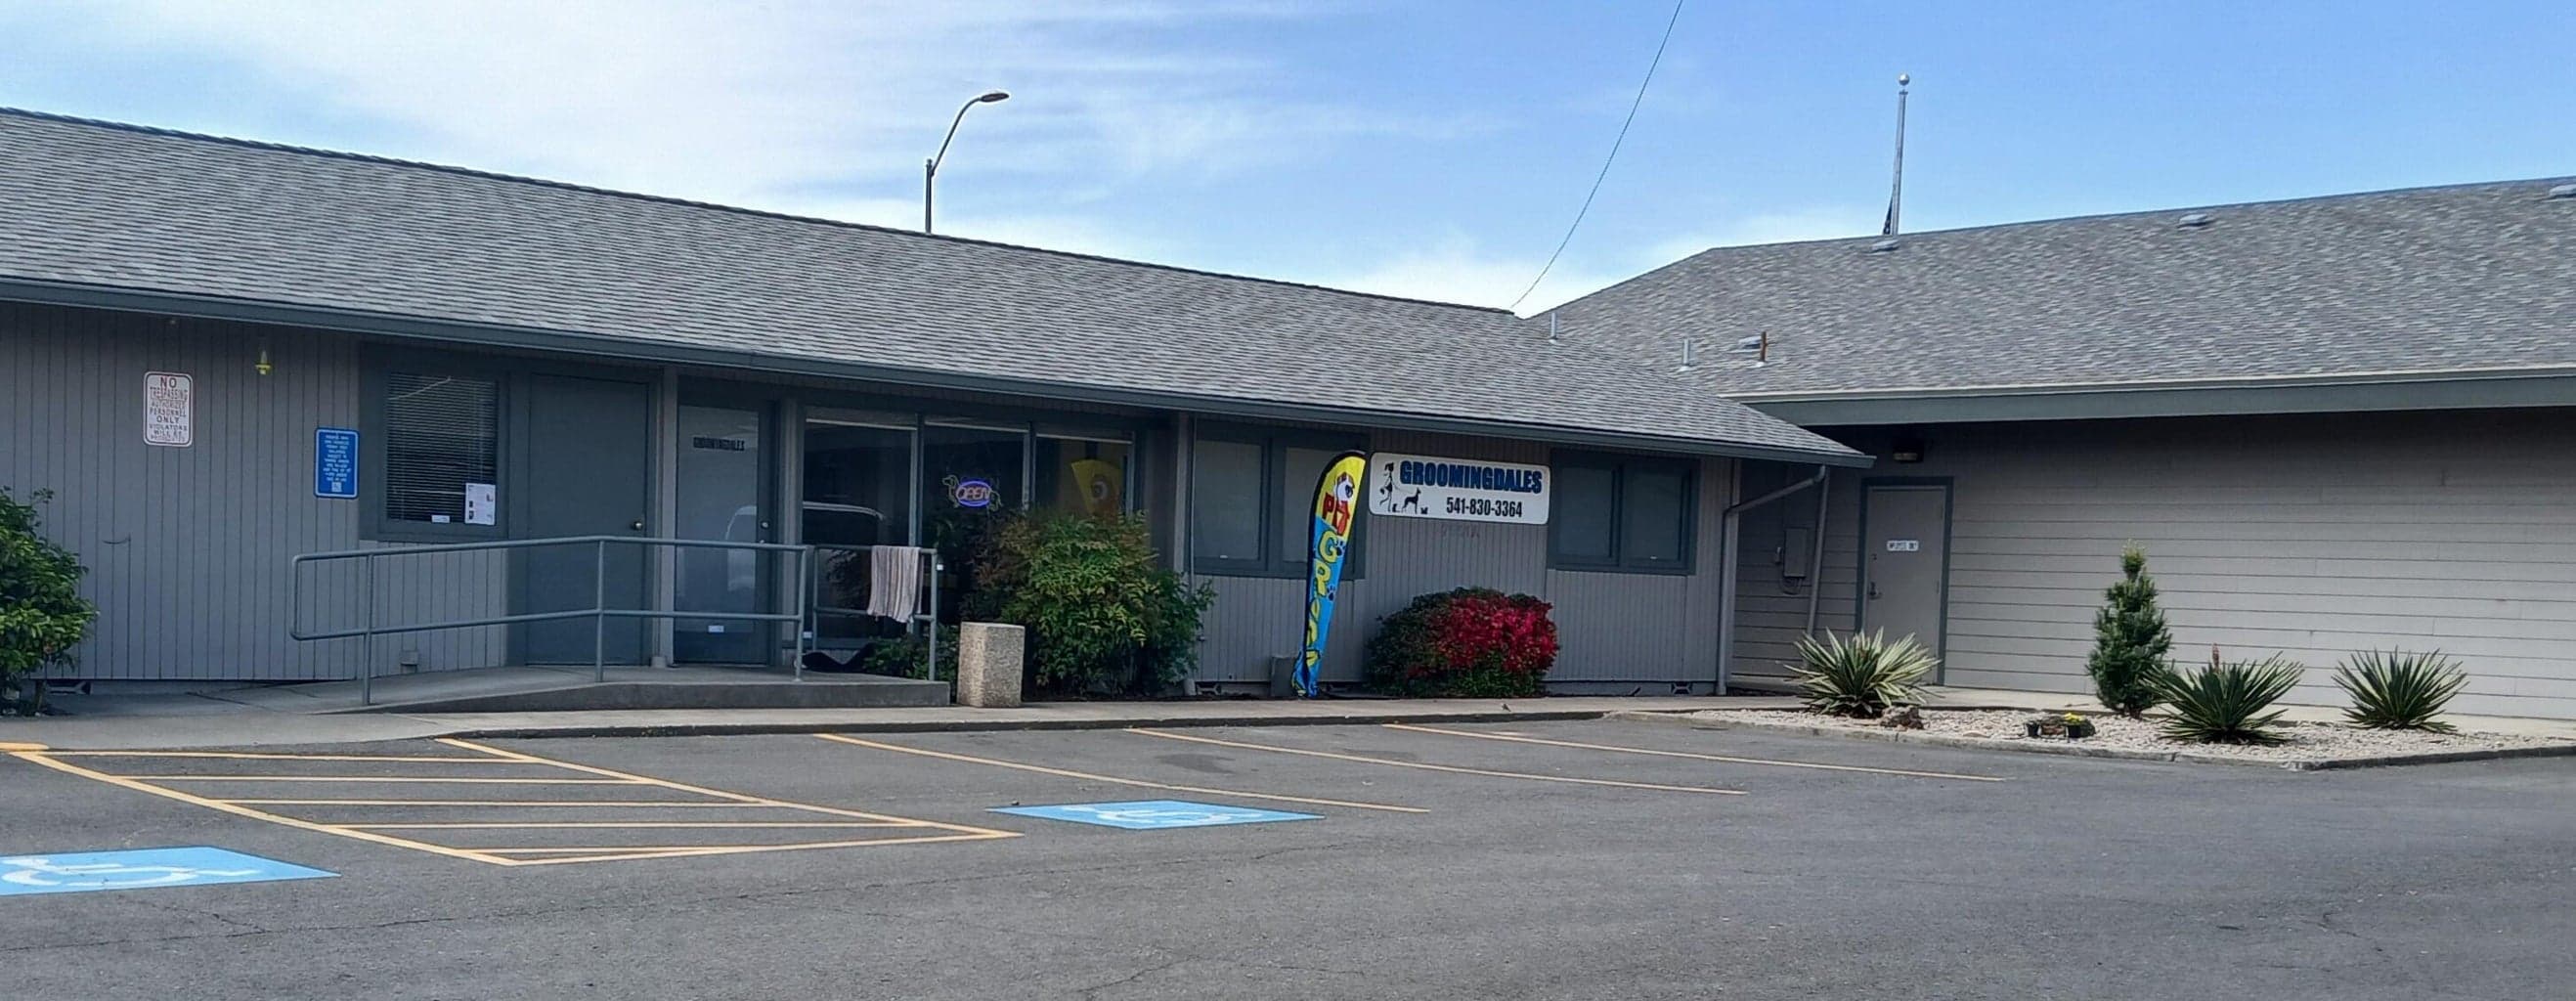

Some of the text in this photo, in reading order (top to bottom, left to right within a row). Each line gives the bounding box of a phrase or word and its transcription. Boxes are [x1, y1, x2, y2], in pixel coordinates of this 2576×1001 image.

[160, 376, 177, 388] NO
[1400, 460, 1543, 494] GROOMINGDALES
[956, 487, 989, 500] OPEN
[1446, 497, 1522, 517] 541-830-3364
